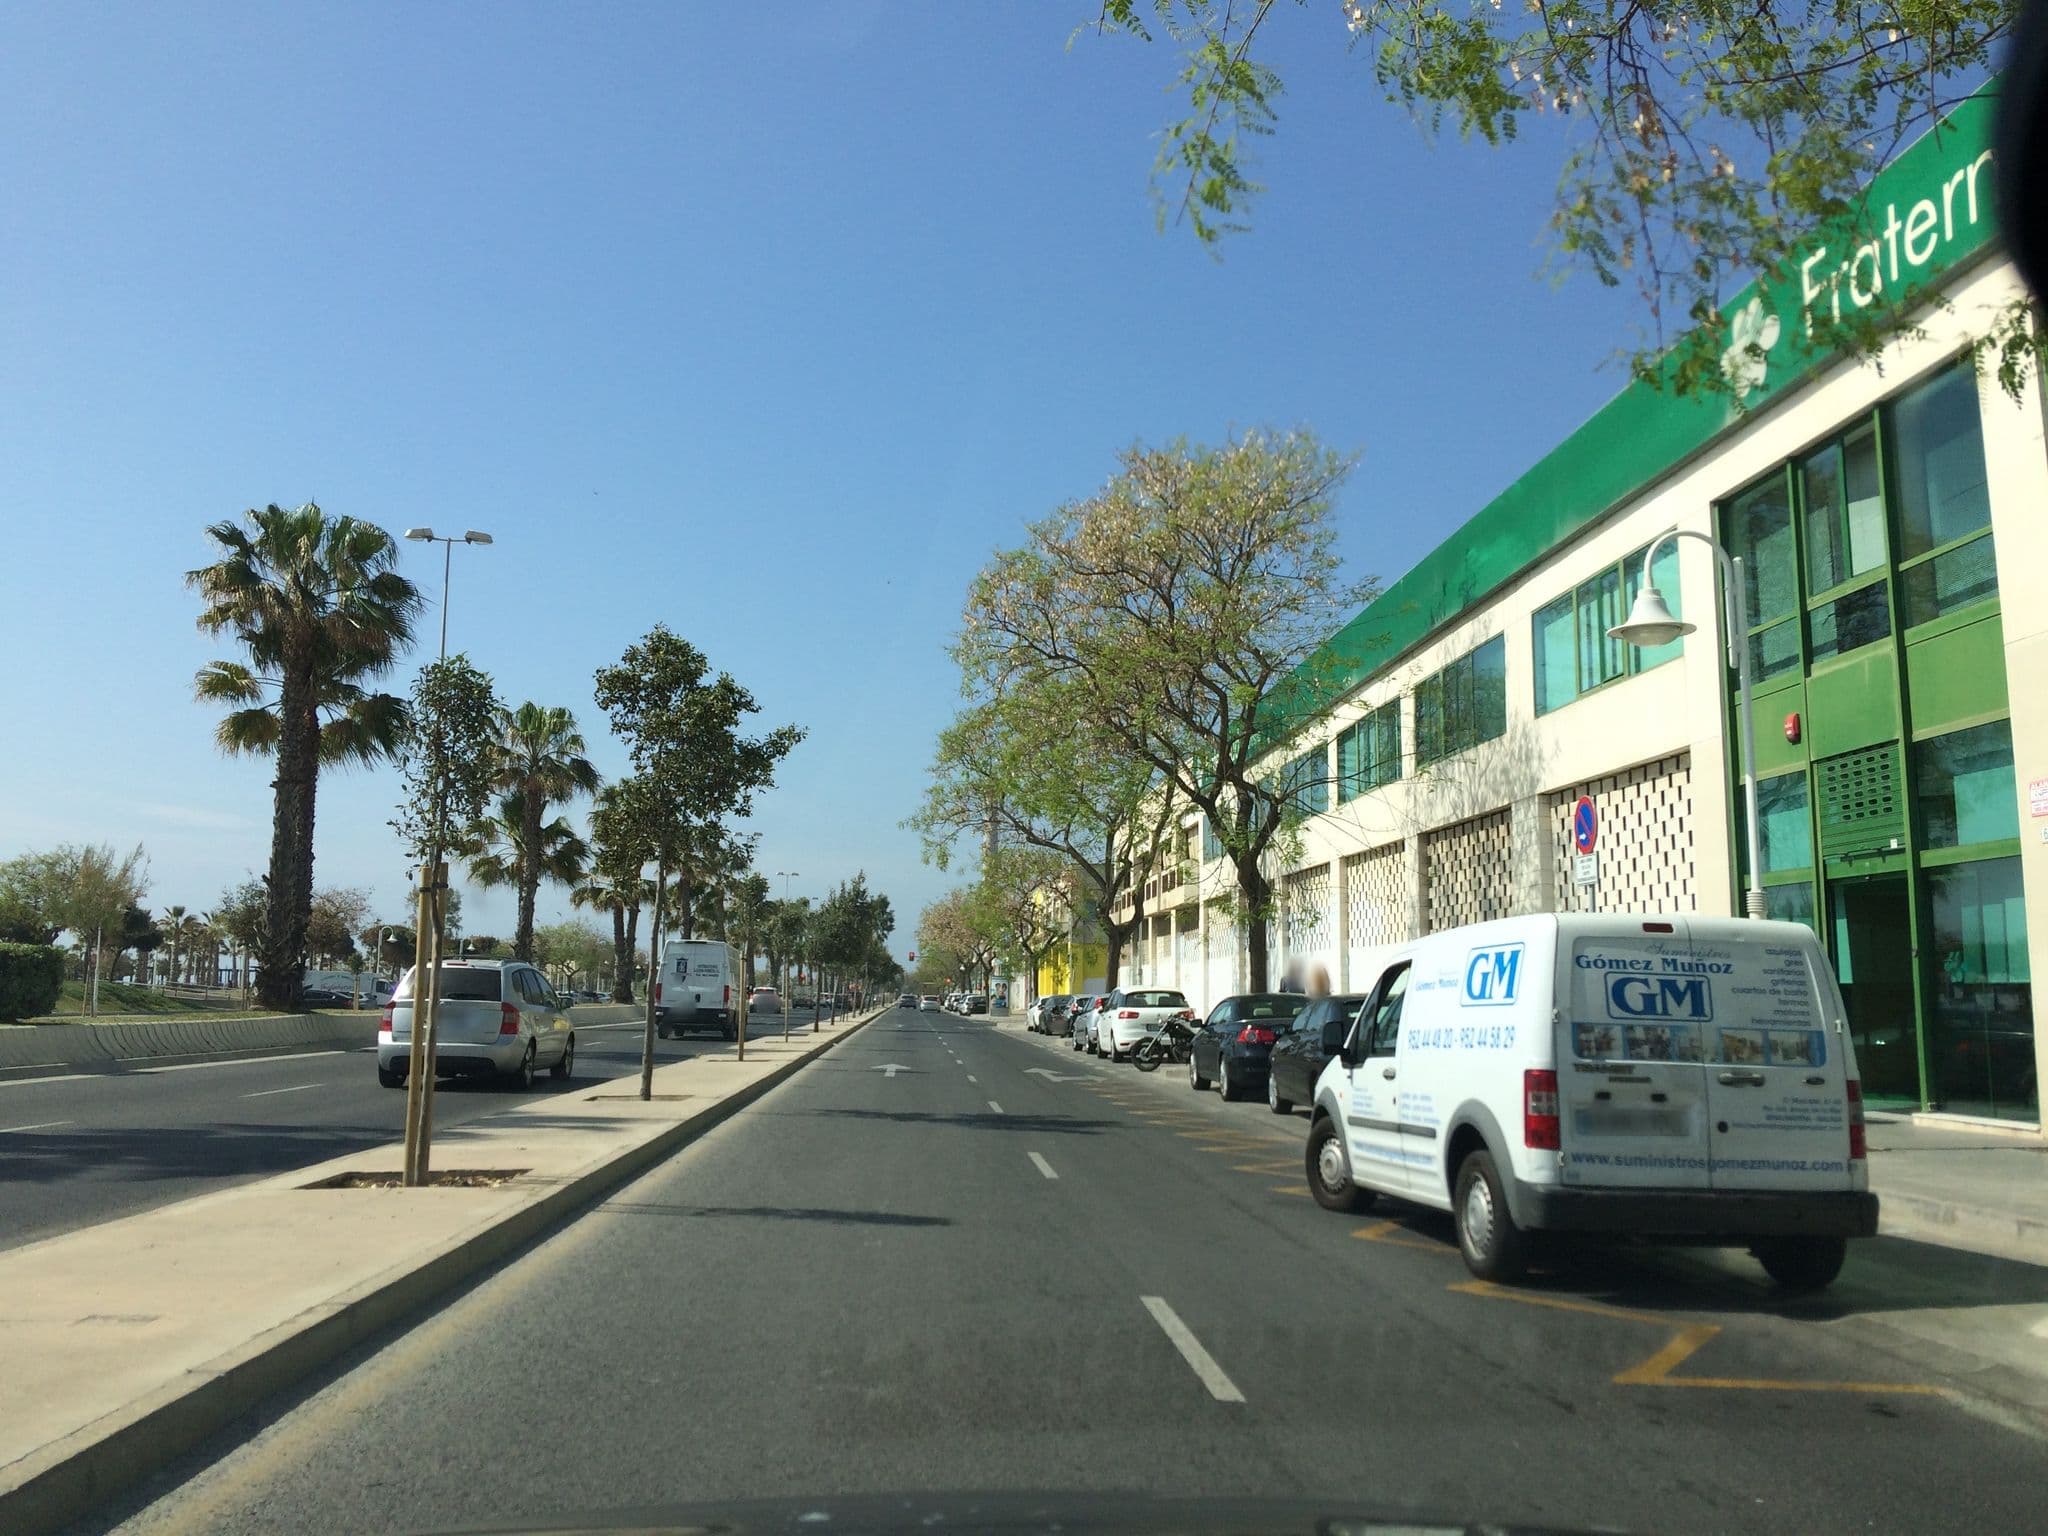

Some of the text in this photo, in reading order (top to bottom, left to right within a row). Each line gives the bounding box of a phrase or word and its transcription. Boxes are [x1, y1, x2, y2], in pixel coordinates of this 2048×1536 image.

[1466, 949, 1521, 1000] GM
[1575, 953, 1734, 975] Gómez Muñoz
[1611, 976, 1709, 1018] GM
[1570, 1151, 1843, 1173] www.suministrosgomezmunoz.com
